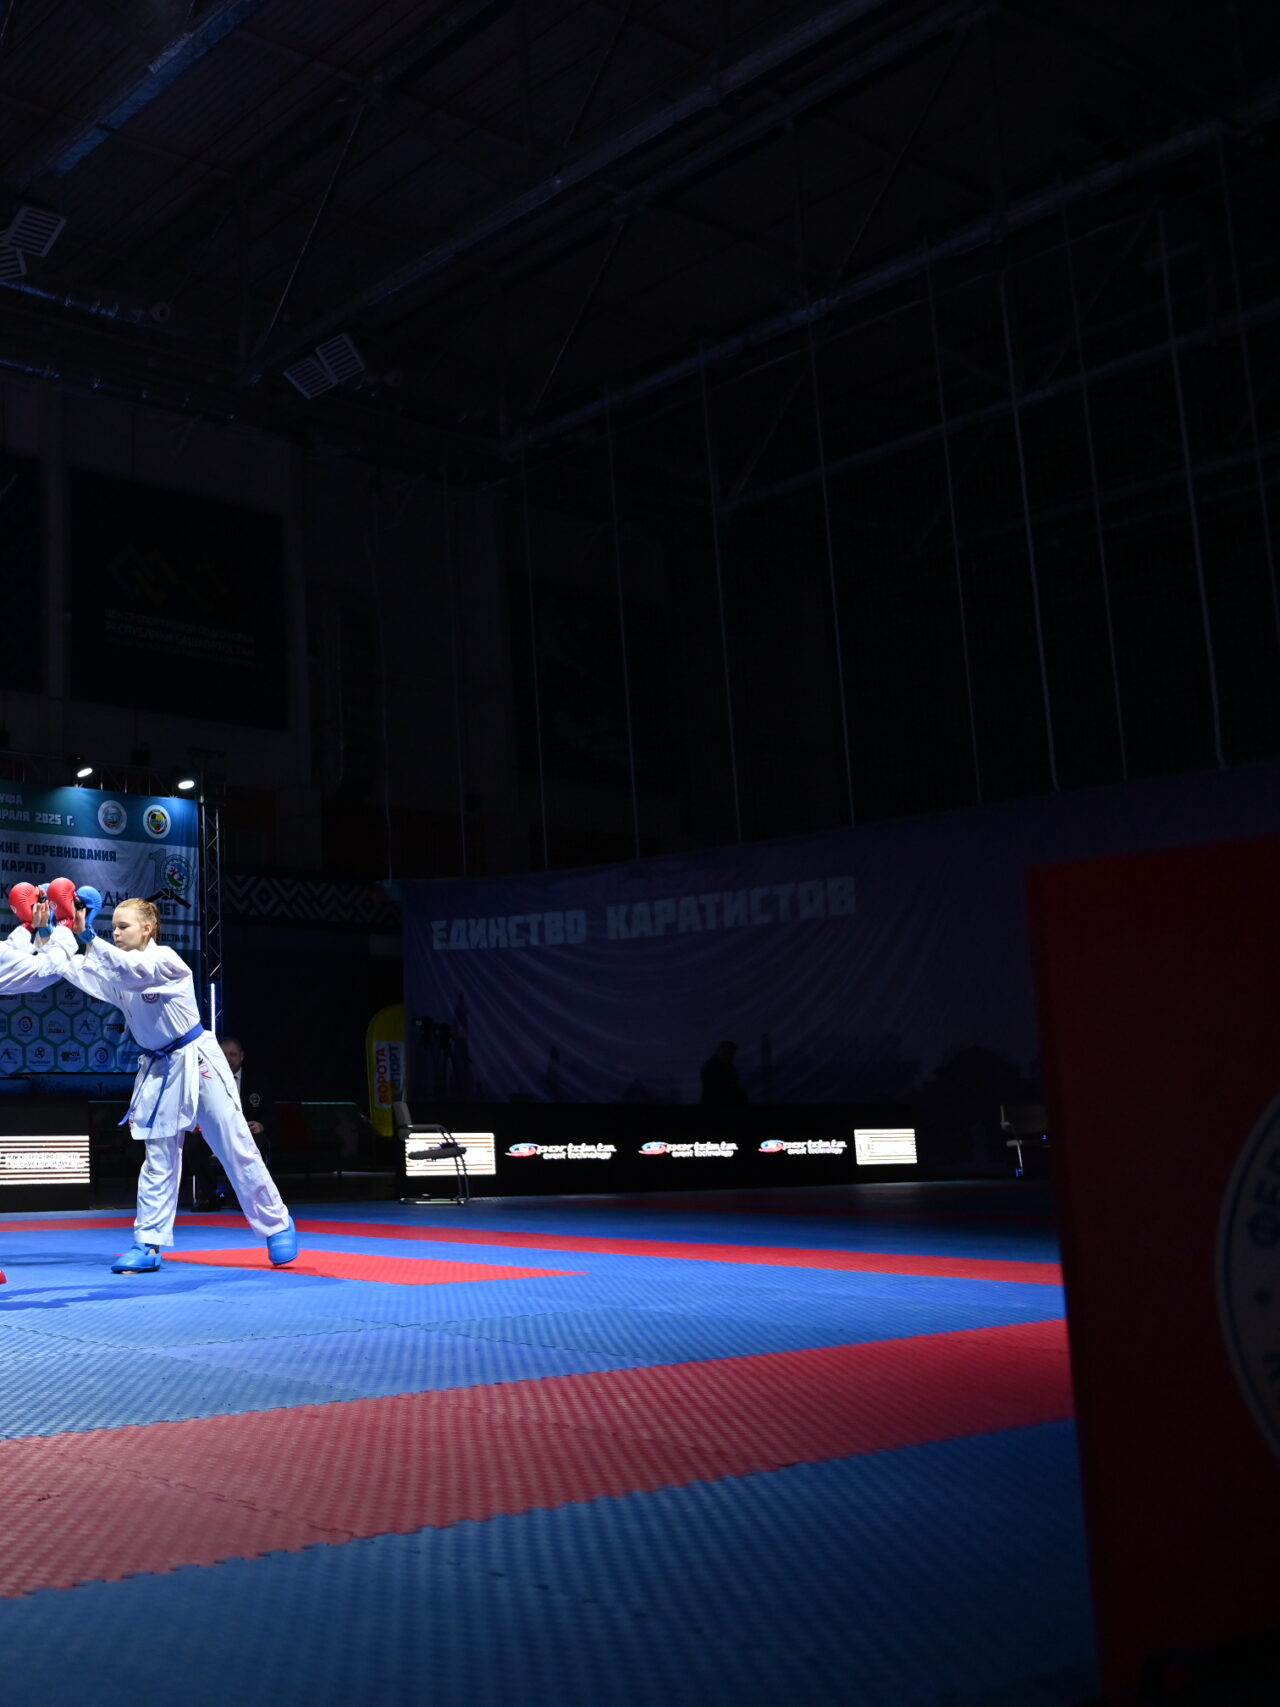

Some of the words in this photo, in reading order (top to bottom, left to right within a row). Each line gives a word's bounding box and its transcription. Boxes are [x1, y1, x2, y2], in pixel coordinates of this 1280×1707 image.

[34, 811, 62, 825] 2025
[26, 844, 117, 862] СОРЕВНОВАНИЯ
[1, 859, 46, 874] КАРАТЭ
[431, 909, 588, 951] ЕДИНСТВО
[607, 875, 857, 941] КАРАТИСТОВ
[376, 1047, 389, 1103] ВОРОТА
